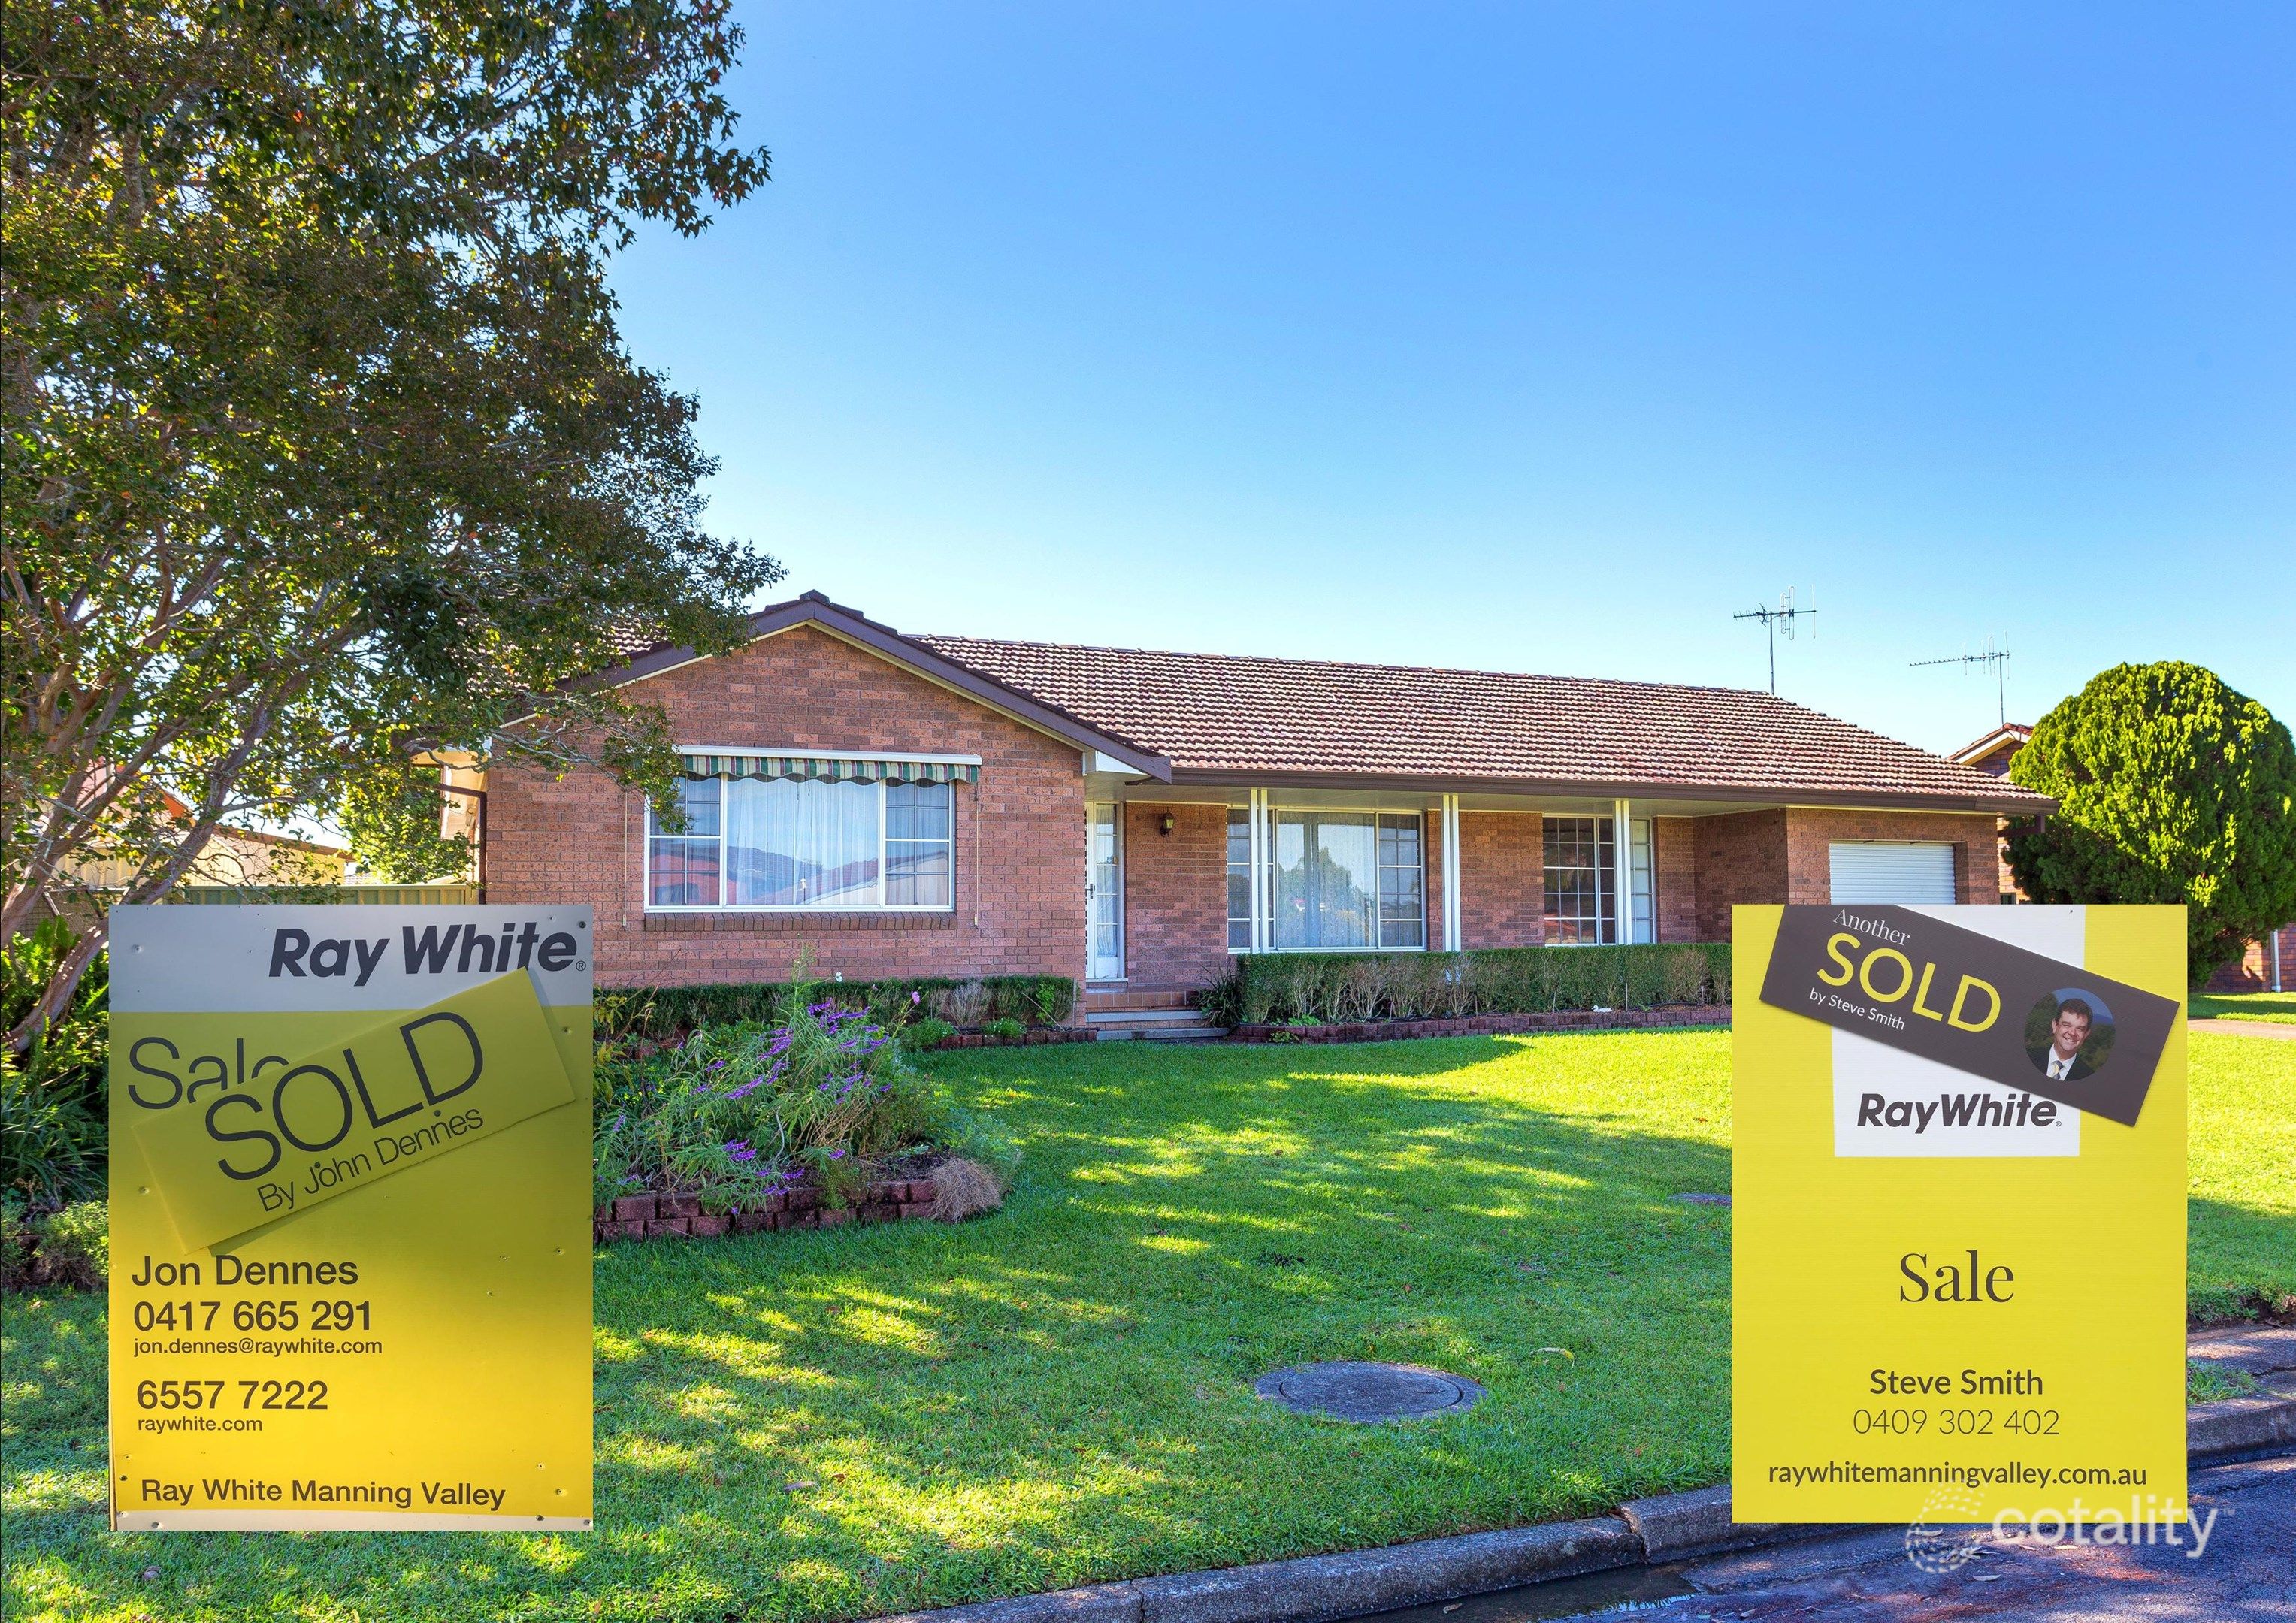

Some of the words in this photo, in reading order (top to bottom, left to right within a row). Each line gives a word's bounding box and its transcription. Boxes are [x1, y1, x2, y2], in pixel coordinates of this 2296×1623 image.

[1832, 908, 1910, 947] Another
[268, 928, 390, 987] Ray
[401, 921, 576, 975] White
[1817, 932, 2001, 1033] SOLD
[1809, 987, 1828, 1005] by
[1829, 995, 1865, 1018] Steve
[1868, 1007, 1904, 1031] Smith
[205, 1011, 483, 1180] SOLD
[256, 1180, 295, 1212] By
[304, 1150, 372, 1195] John
[374, 1108, 484, 1165] Dennes
[132, 1255, 201, 1286] Jon
[215, 1255, 358, 1286] Dennes
[1899, 1250, 2015, 1302] Sale
[133, 1301, 221, 1331] 0417
[232, 1301, 299, 1331] 665
[311, 1300, 371, 1331] 291
[133, 1337, 383, 1357] jon.dennes@raywhite.com
[137, 1380, 225, 1410] 6557
[238, 1380, 328, 1410] 7222
[1870, 1369, 1952, 1395] Steve
[1960, 1369, 2043, 1395] Smith
[138, 1416, 263, 1434] raywhite.com
[1853, 1409, 1928, 1434] 0409
[1939, 1409, 1993, 1435] 302
[2004, 1409, 2060, 1436] 402
[1768, 1461, 2146, 1489] raywhitemanningvalley.com.au
[141, 1480, 194, 1506] Ray
[203, 1479, 283, 1501] White
[292, 1480, 412, 1508] Manning
[421, 1482, 506, 1510] Valley
